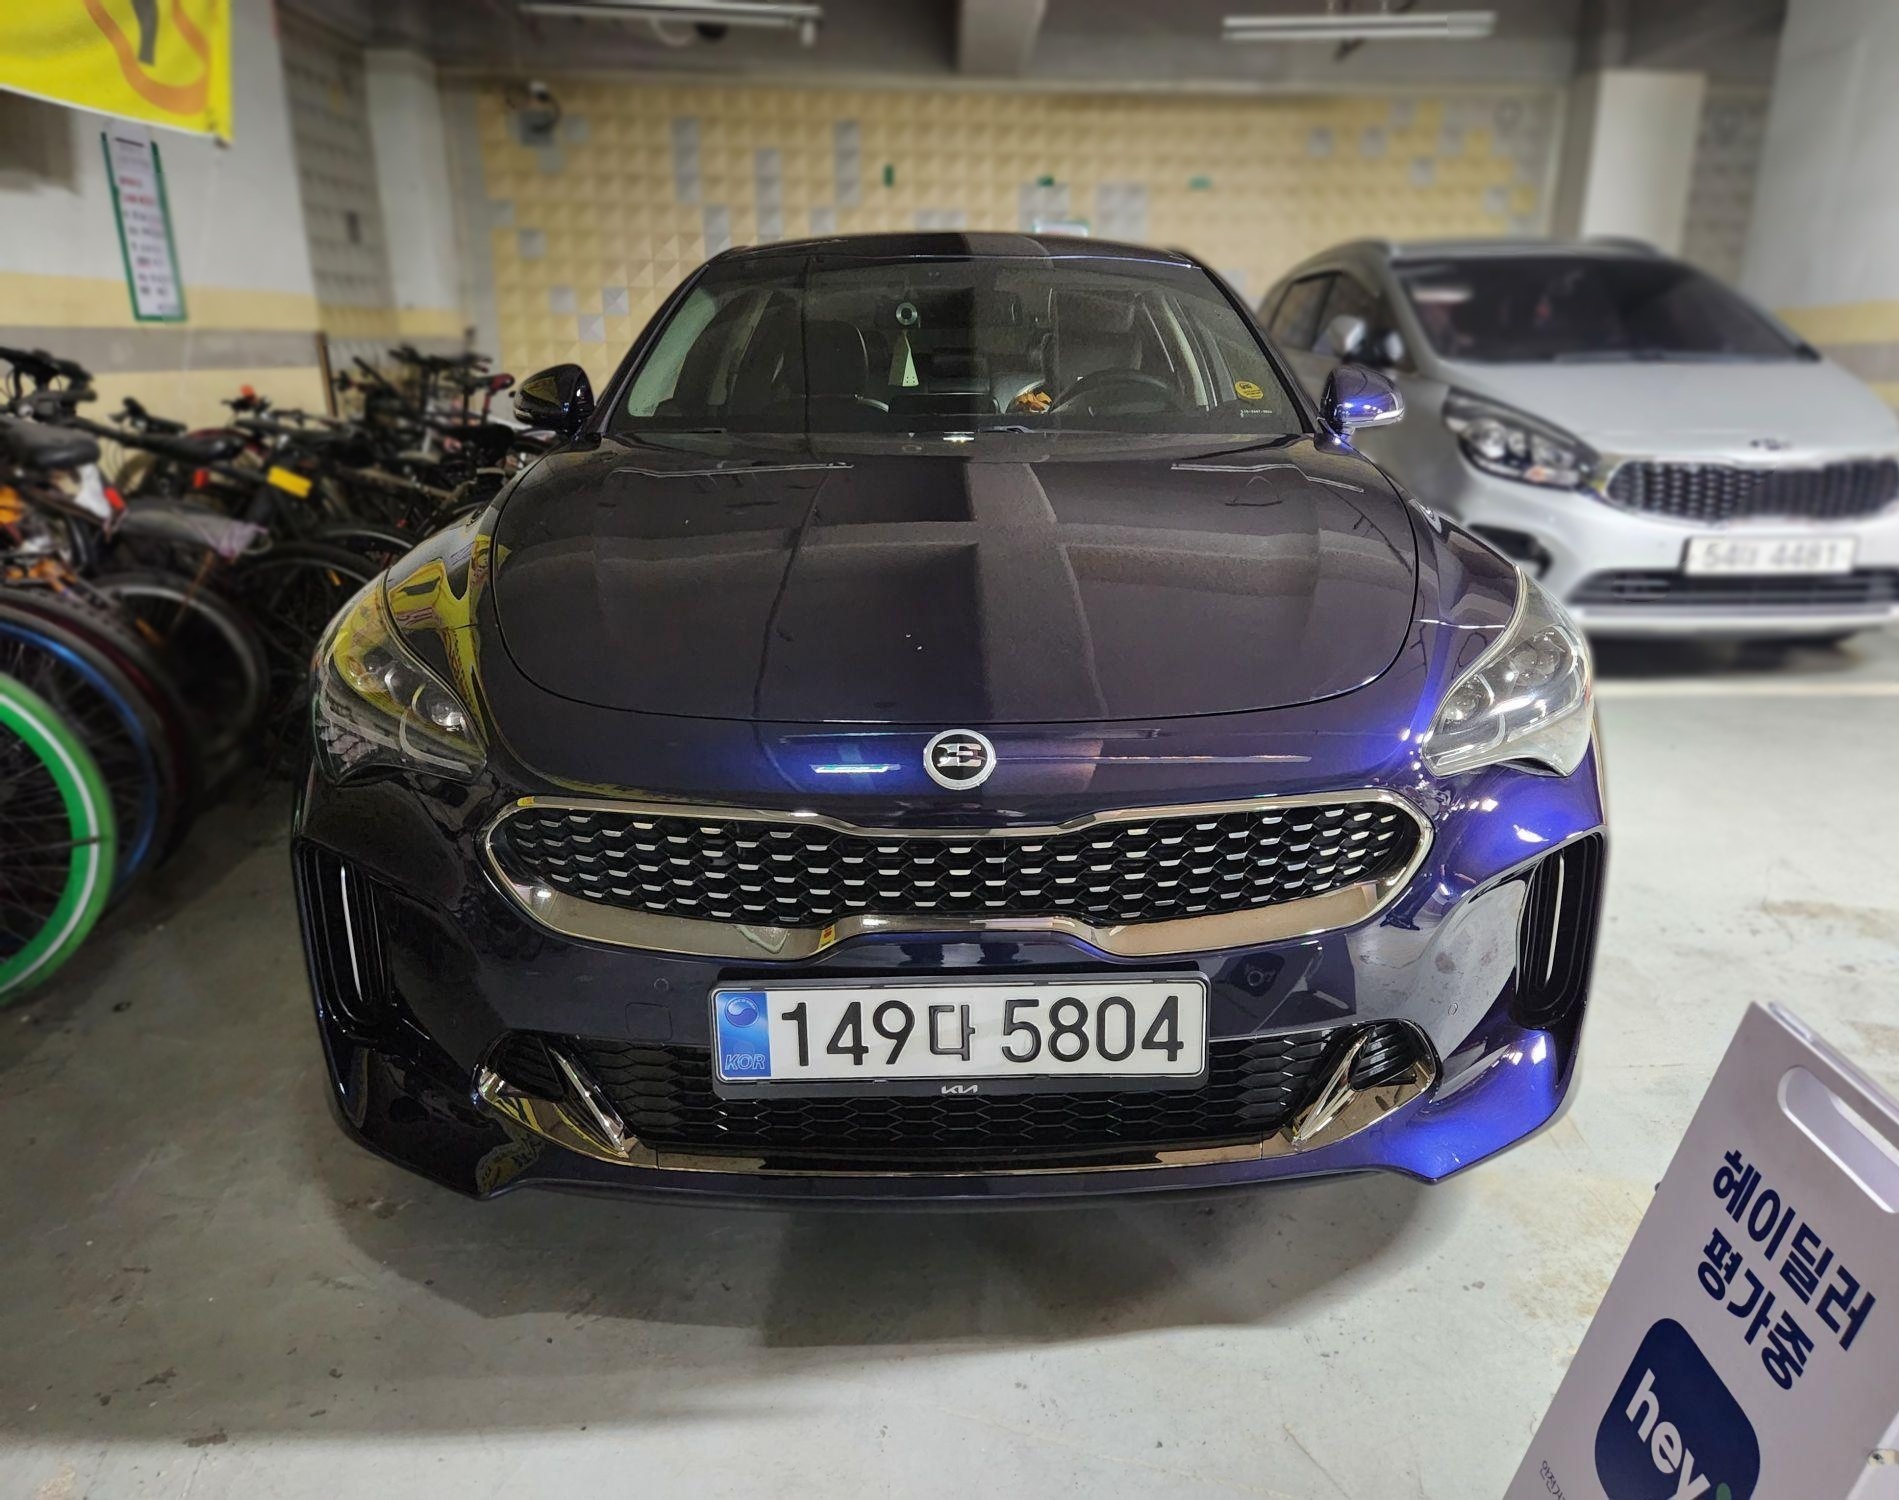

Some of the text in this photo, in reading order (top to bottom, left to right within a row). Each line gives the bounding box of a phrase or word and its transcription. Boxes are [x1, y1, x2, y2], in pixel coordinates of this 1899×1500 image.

[724, 1053, 766, 1070] KOR
[781, 996, 1184, 1067] 149다 5804
[1697, 1228, 1815, 1390] 평가중
[1713, 1150, 1876, 1351] 헤이딜러
[1625, 1367, 1711, 1500] hey
